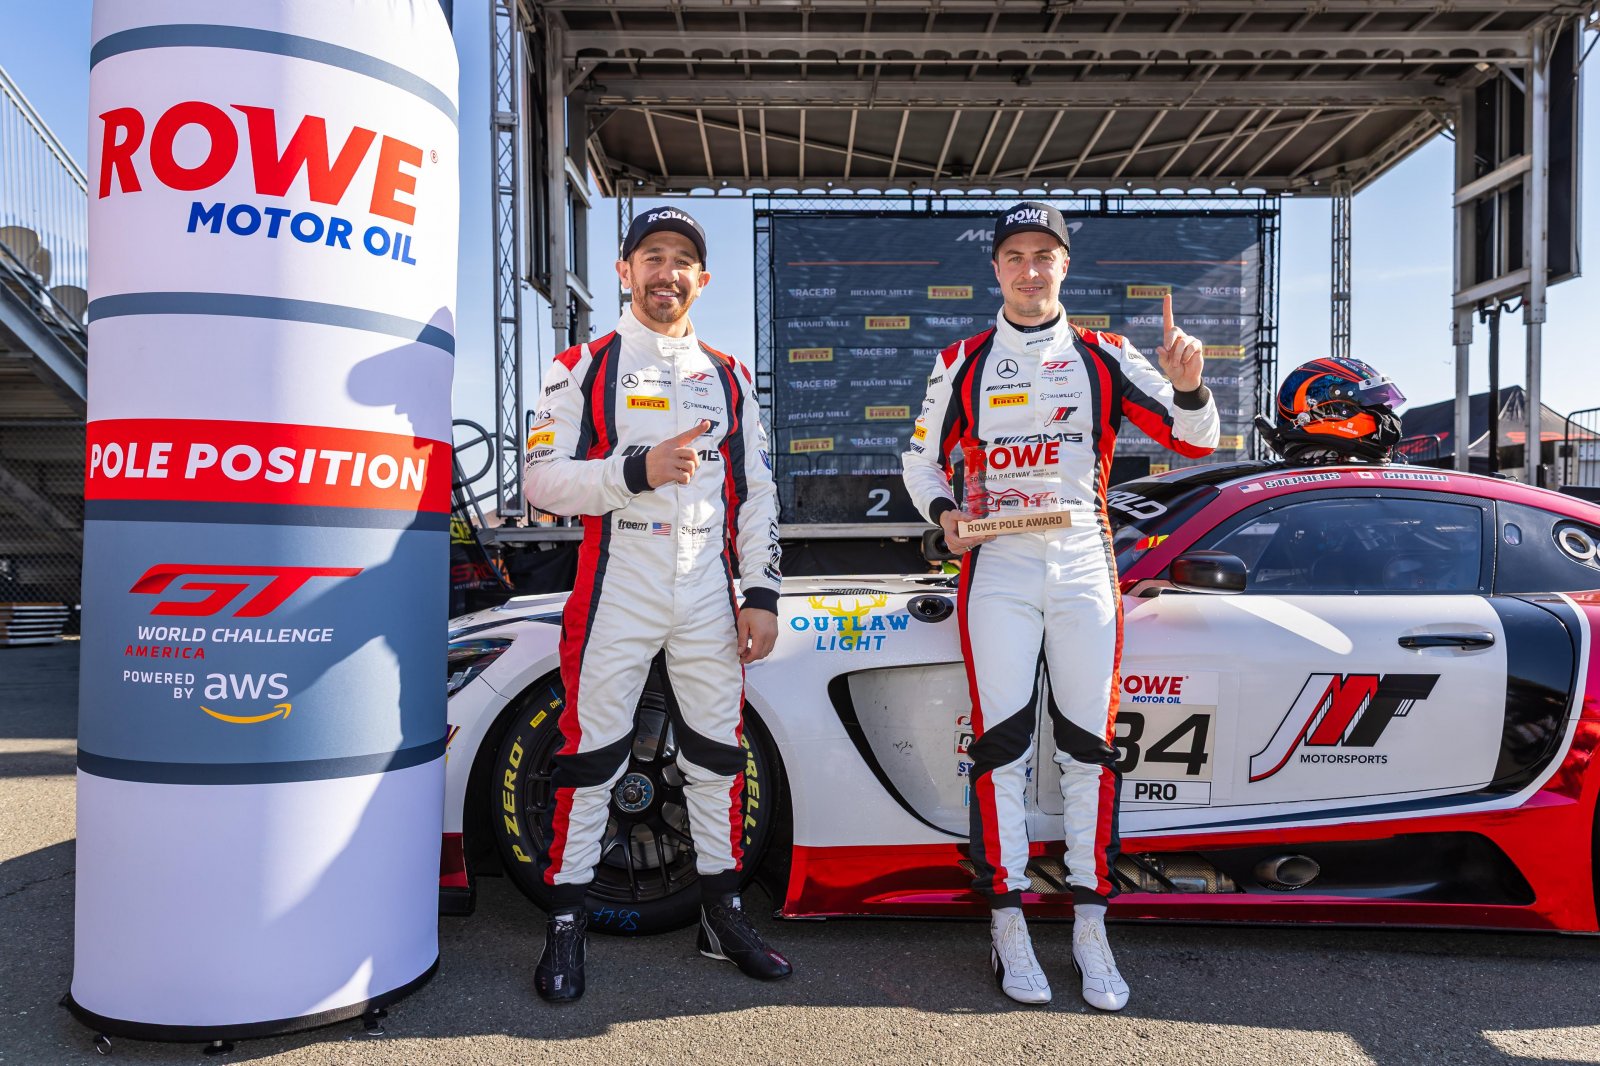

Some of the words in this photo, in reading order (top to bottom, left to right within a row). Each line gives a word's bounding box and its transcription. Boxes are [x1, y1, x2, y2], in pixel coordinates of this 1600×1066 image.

[98, 101, 424, 226] ROWE
[647, 210, 694, 226] ROWE
[1005, 208, 1049, 226] ROWE
[186, 201, 353, 250] MOTOR
[363, 226, 417, 266] OIL
[850, 289, 887, 297] RICHARD
[931, 288, 969, 297] PIRELLI
[1059, 288, 1086, 296] HARD
[1087, 288, 1112, 296] MILLE
[788, 320, 824, 328] RICHARD
[826, 319, 850, 327] MILLE
[869, 318, 906, 328] PIRELLI
[1183, 318, 1220, 326] RICHARD
[1221, 318, 1246, 326] MILLE
[793, 349, 829, 360] PIRELLI
[850, 379, 887, 387] RICHARD
[631, 398, 665, 409] PIRELLI
[993, 395, 1024, 405] PIRELLI
[788, 411, 824, 420] RICHARD
[826, 410, 850, 418] MILLE
[869, 407, 906, 418] PIRELLI
[1219, 408, 1244, 416] MILLE
[793, 440, 830, 451] PIRELLI
[968, 441, 1060, 474] ROWE
[89, 442, 173, 479] POLE
[184, 443, 427, 492] POSITION
[886, 468, 904, 476] MIL
[998, 470, 1031, 480] RACEWAY
[1264, 472, 1340, 488] STEPHENS
[1382, 471, 1448, 482] GRENIER
[865, 488, 891, 517] 2
[994, 497, 1019, 507] freem
[1060, 497, 1082, 505] Grenier
[1106, 490, 1168, 520] RLD
[618, 518, 649, 531] freem
[967, 522, 997, 533] ROWE
[999, 519, 1023, 530] POLE
[1025, 516, 1062, 527] AWARD
[790, 614, 910, 631] OUTLAW
[138, 625, 206, 642] WORLD
[211, 628, 334, 643] CHALLENGE
[816, 635, 887, 651] LIGHT
[125, 645, 206, 660] AMERICA
[123, 670, 195, 685] POWERED
[203, 672, 288, 700] aws
[173, 687, 195, 699] BY
[1132, 695, 1165, 704] MOTOR
[1166, 696, 1182, 704] OIL
[1300, 753, 1388, 765] MOTORSPORTS
[503, 741, 524, 837] ZERO
[1134, 782, 1177, 801] PRO
[512, 844, 532, 863] P
